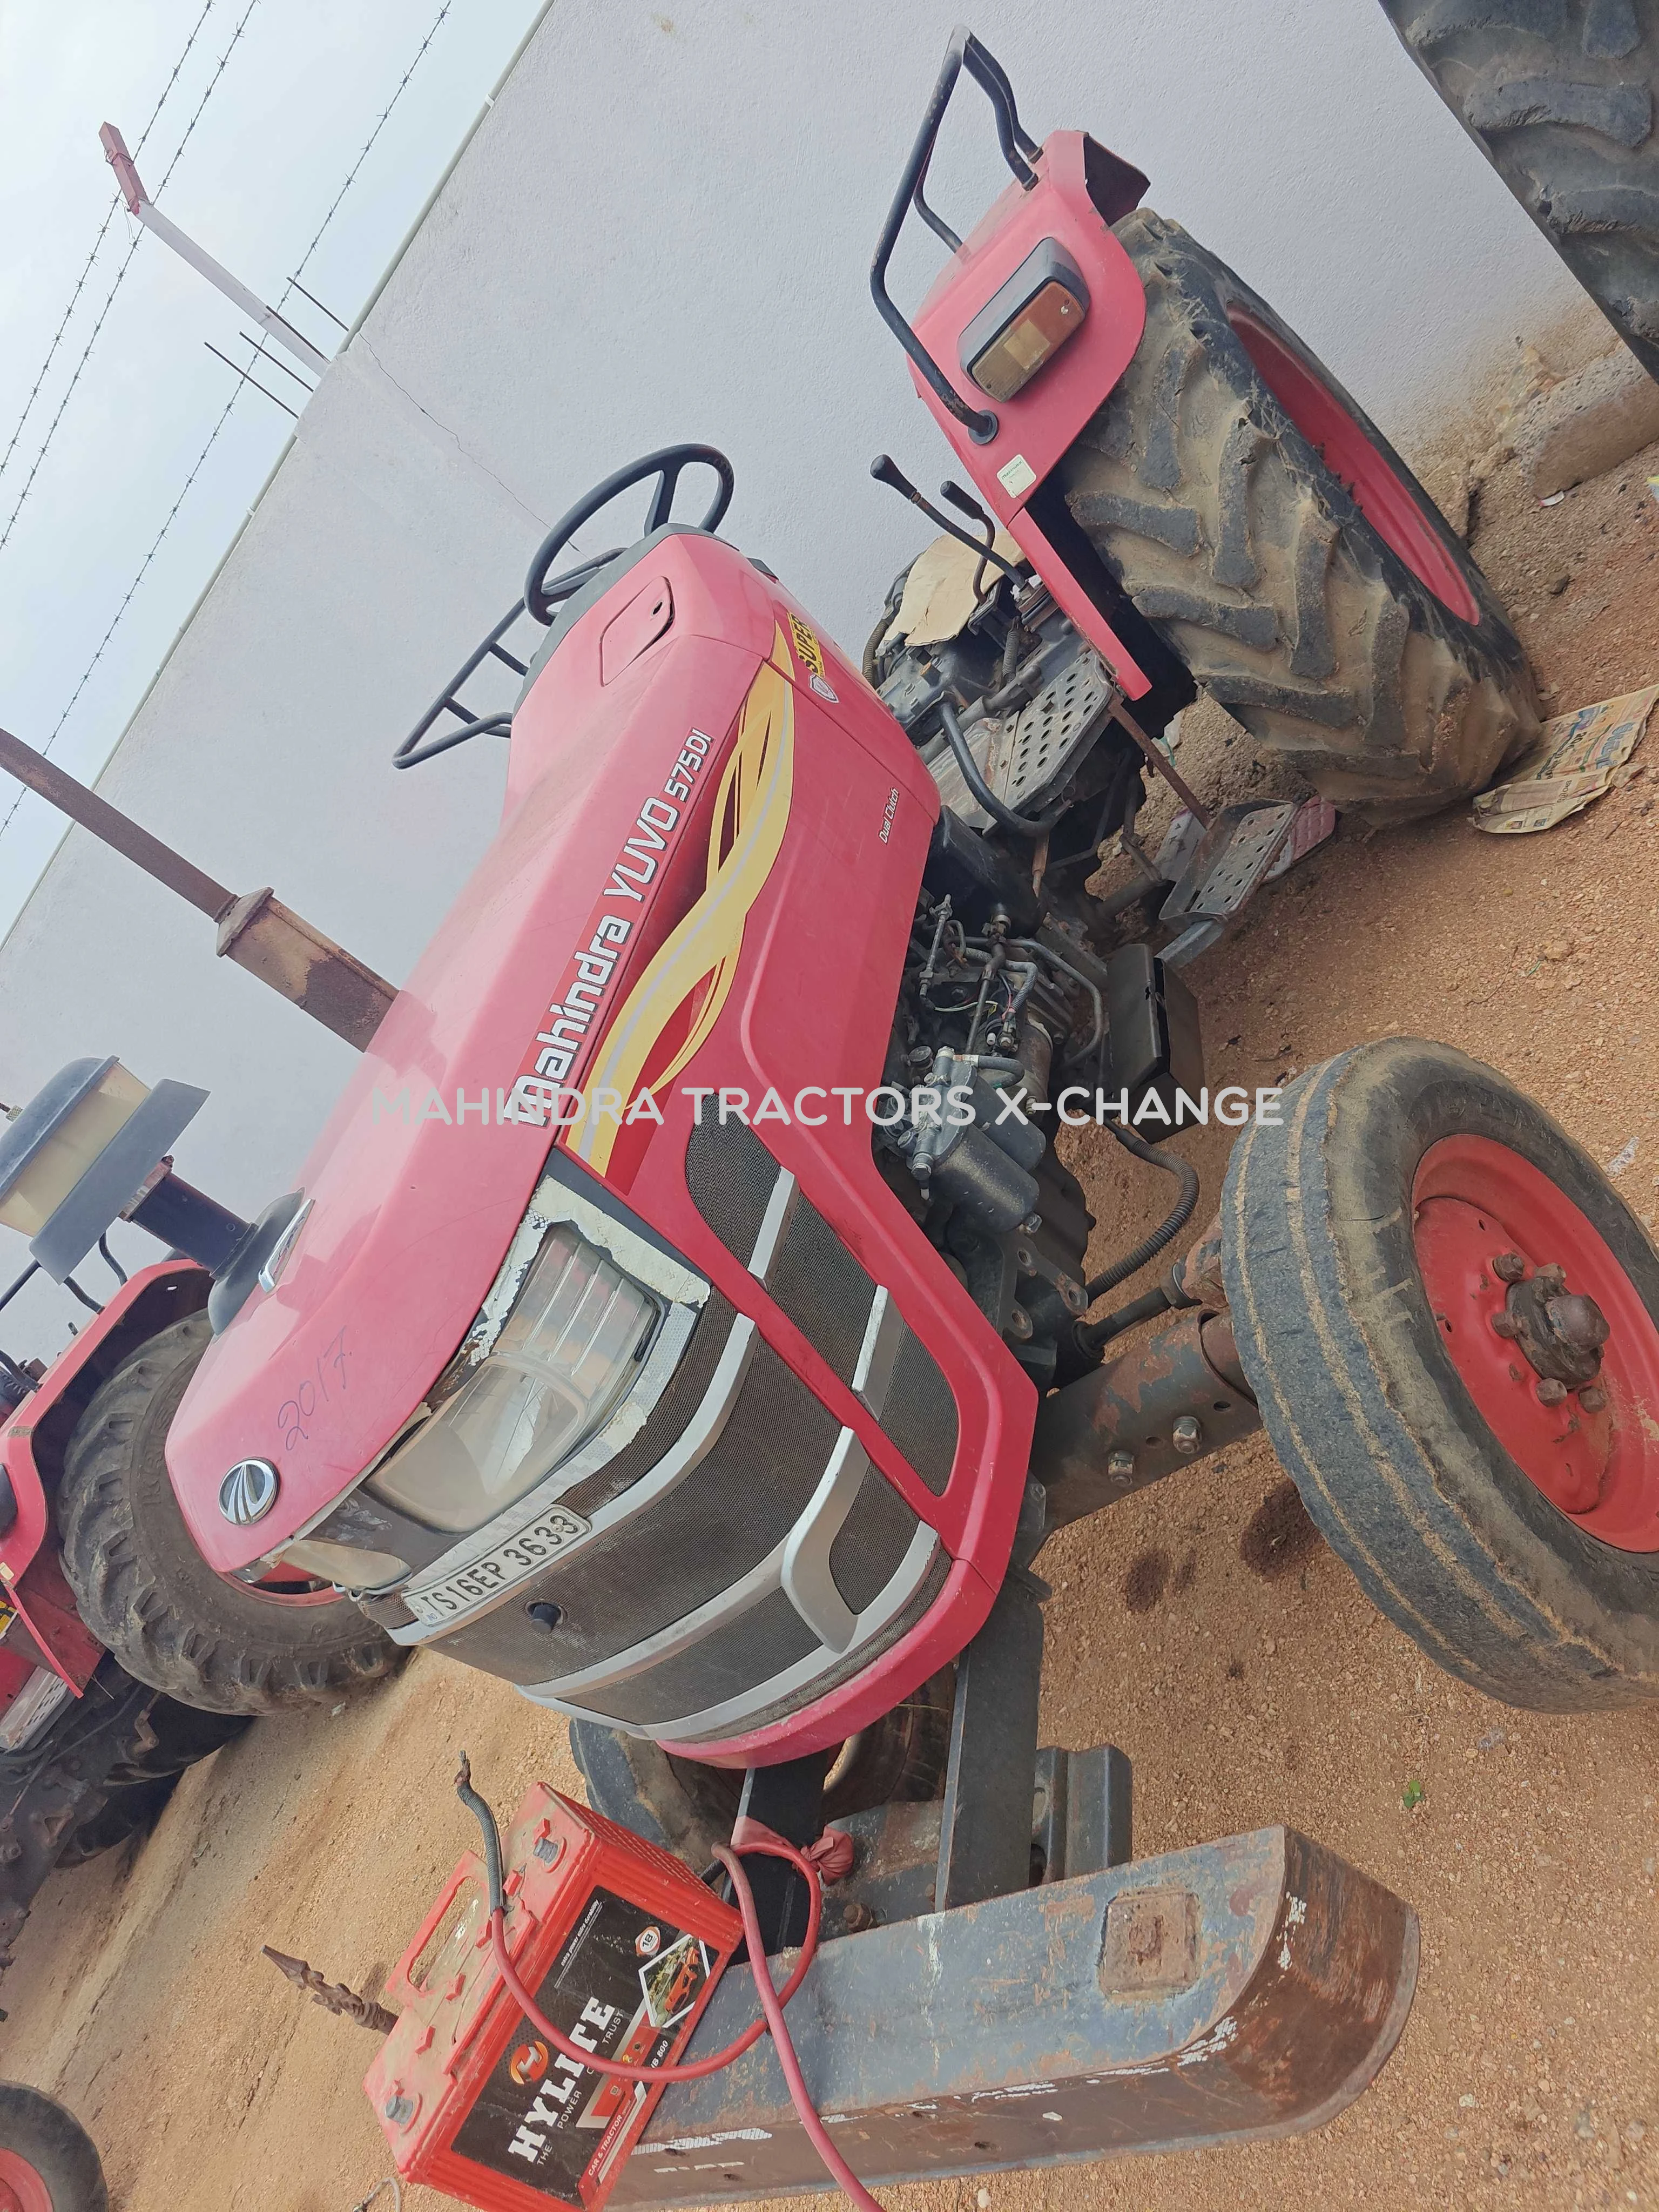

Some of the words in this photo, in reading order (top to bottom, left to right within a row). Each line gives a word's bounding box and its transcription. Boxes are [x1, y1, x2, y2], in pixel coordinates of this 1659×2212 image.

[791, 614, 819, 673] SUPER
[879, 817, 891, 844] Dual
[885, 788, 899, 820] Clutch
[503, 915, 632, 1126] Mahindra
[604, 796, 680, 902] YUVO
[664, 727, 712, 802] 575DI
[278, 1325, 347, 1451] 2017
[421, 1562, 505, 1616] TS16EP
[503, 1514, 578, 1566] 3633
[508, 1997, 615, 2163] HYLITE
[536, 2144, 553, 2166] THE
[557, 2089, 582, 2129] POWER
[602, 2010, 624, 2045] TRUST
[657, 2040, 669, 2058] 800
[588, 2159, 600, 2176] CAR
[601, 2115, 623, 2152] TRACTOR
